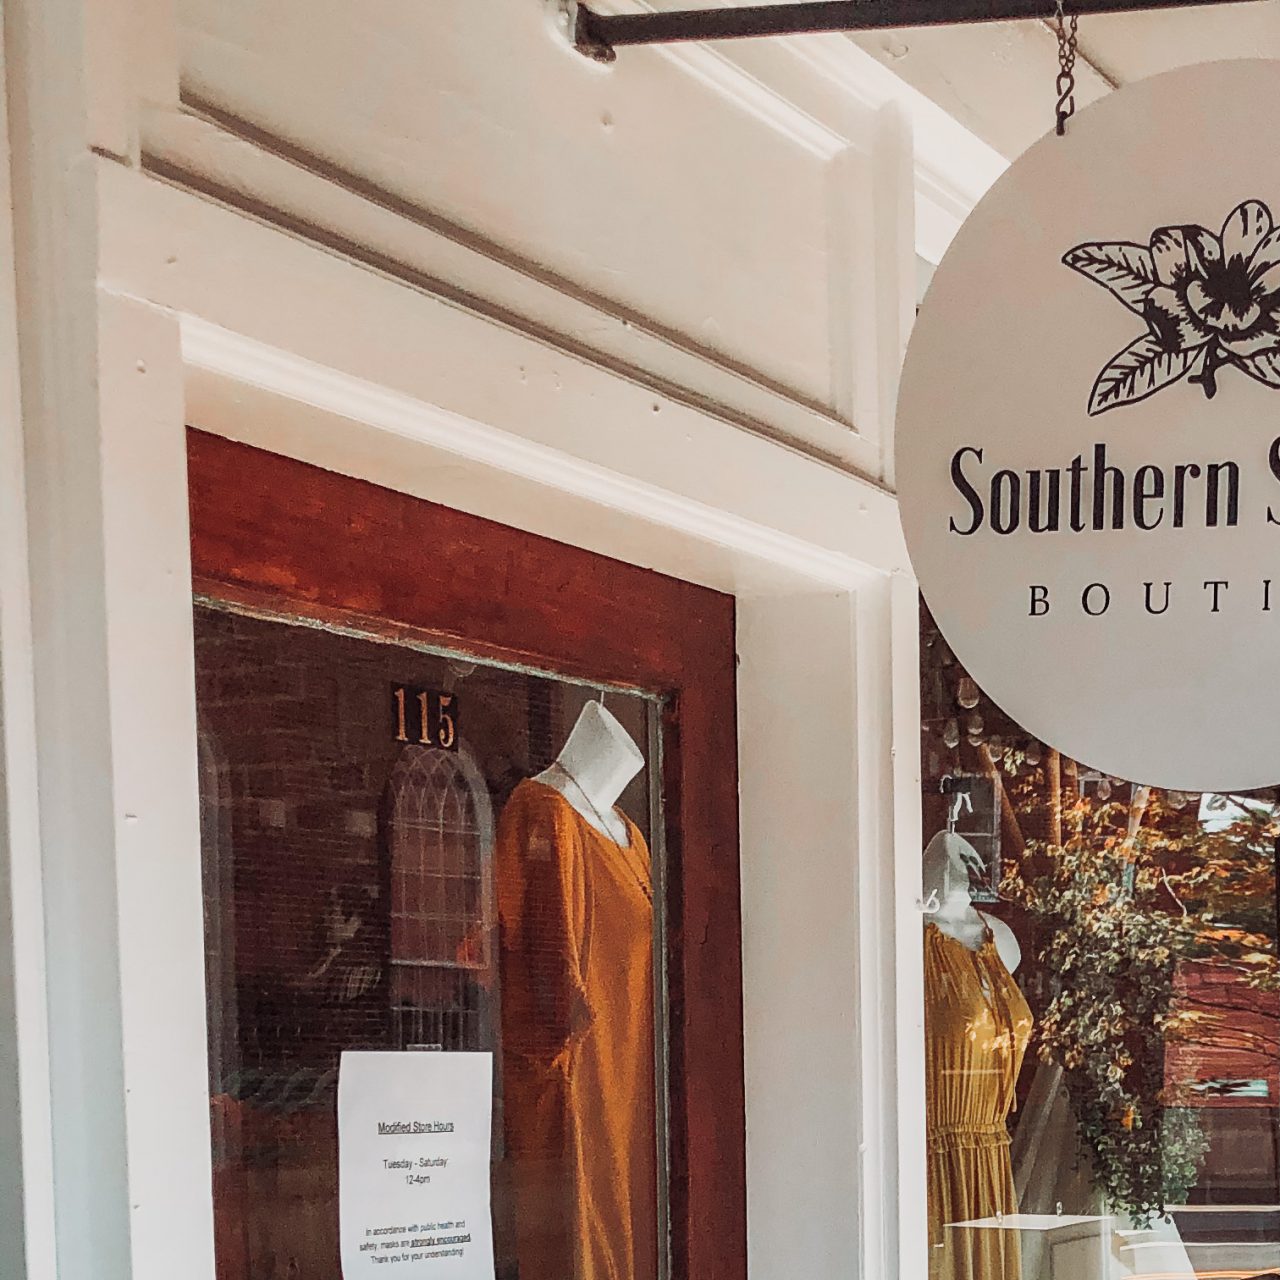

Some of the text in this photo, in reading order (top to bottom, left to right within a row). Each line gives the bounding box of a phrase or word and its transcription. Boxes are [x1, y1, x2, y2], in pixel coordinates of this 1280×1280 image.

[949, 443, 1240, 536] Southern
[394, 687, 455, 748] 115
[378, 1120, 454, 1135] Modified Store Hours
[383, 1159, 413, 1170] Tuesday
[419, 1156, 448, 1168] Saturday
